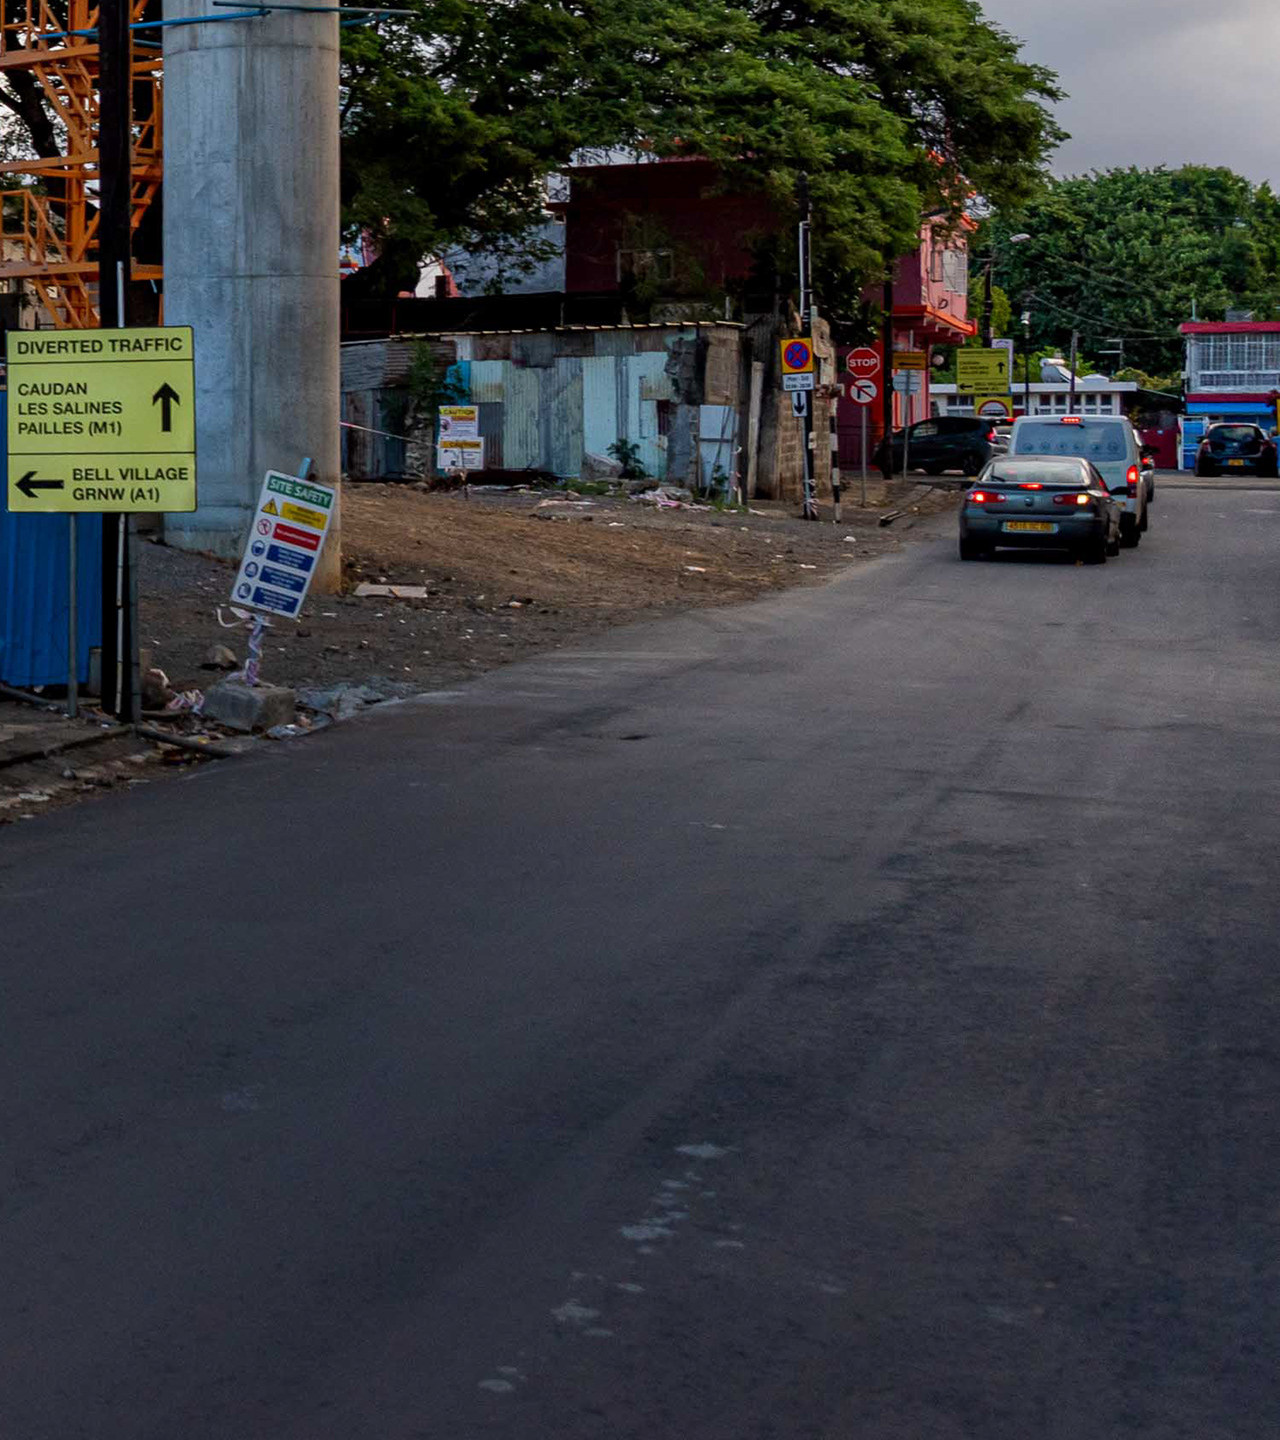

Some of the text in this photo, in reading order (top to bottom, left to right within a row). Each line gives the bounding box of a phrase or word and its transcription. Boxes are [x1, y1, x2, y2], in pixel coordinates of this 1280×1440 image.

[17, 337, 183, 355] DIVERTED TRAFFIC
[849, 358, 877, 367] STOP
[17, 382, 87, 396] CAUDAN
[18, 401, 123, 415] LES SALINES
[18, 421, 122, 436] PAILLES (M1)
[72, 467, 188, 481] BELL VILLAGE
[72, 487, 160, 503] GRNW (A1)
[269, 479, 331, 506] SITE SAFETY
